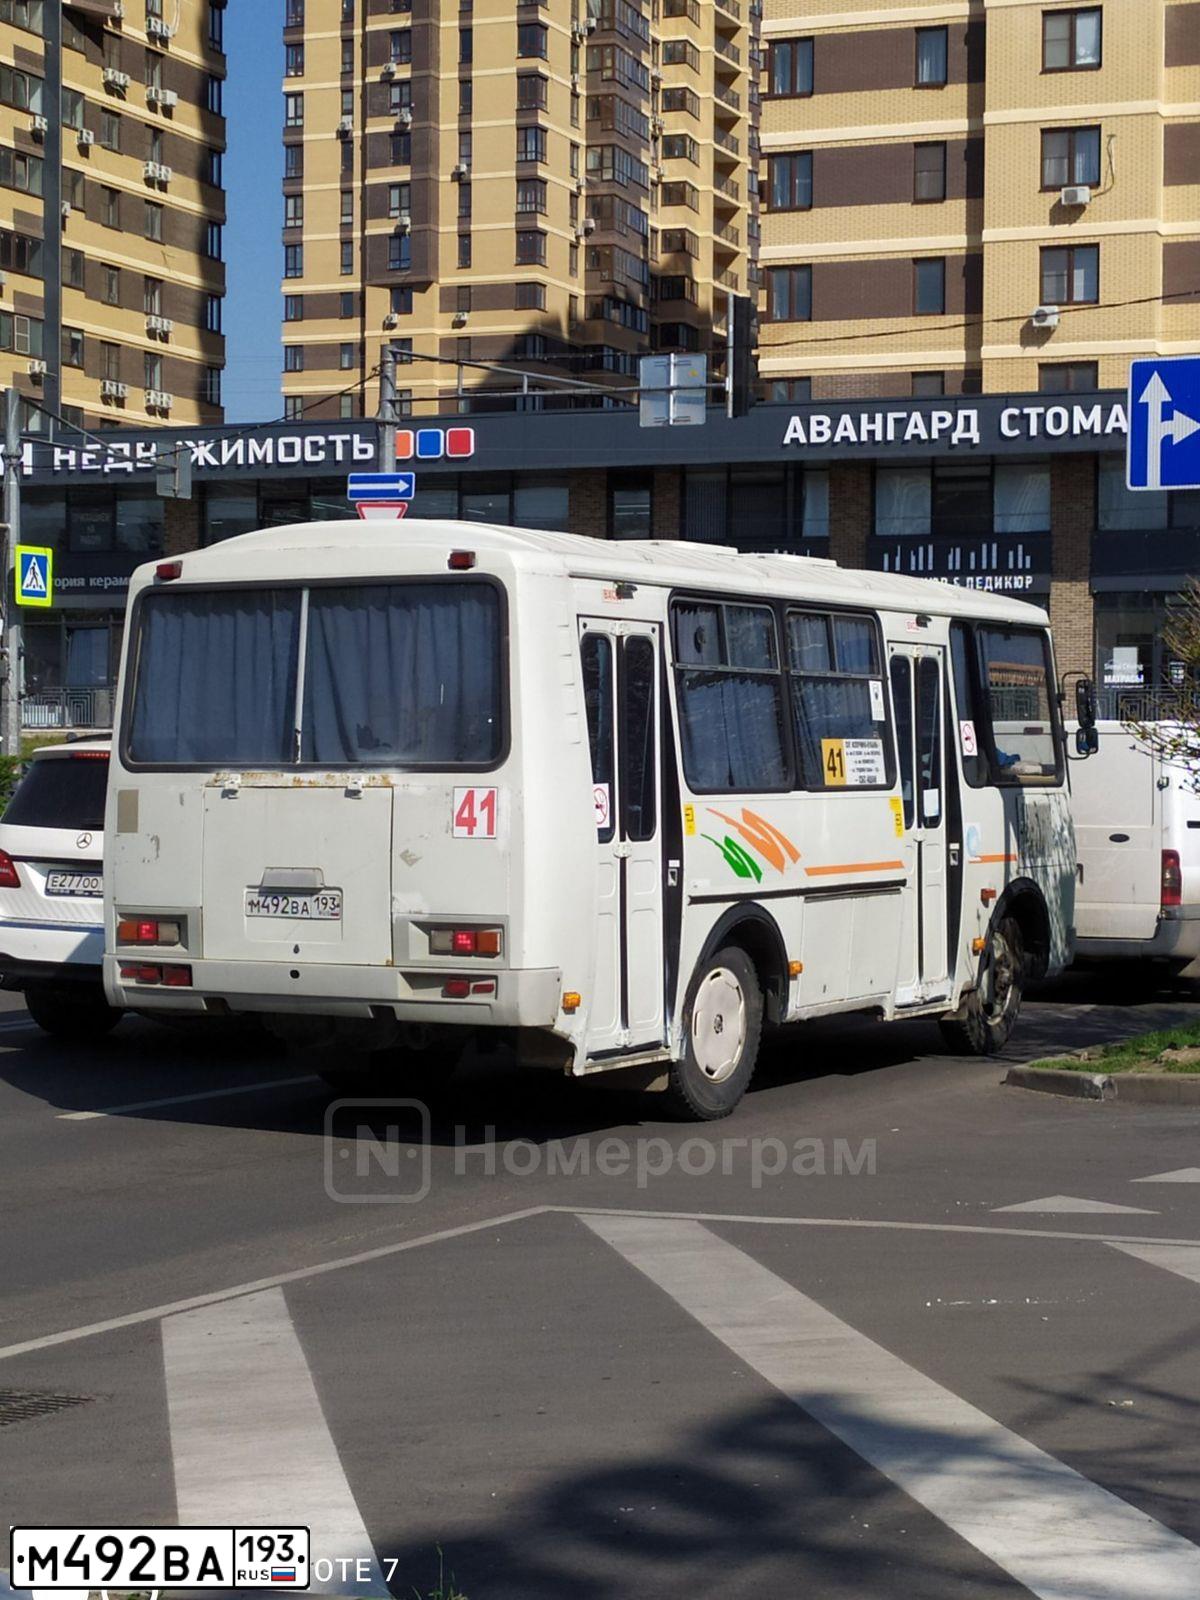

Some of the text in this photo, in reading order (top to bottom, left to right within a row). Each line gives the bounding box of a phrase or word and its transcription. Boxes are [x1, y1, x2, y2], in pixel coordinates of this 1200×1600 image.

[783, 404, 1128, 444] АВАНГАРД СТОМА
[53, 434, 374, 472] НЕДВЖИМОСТЬ
[966, 576, 1033, 591] ПЕДИКЮР
[826, 748, 844, 778] 41
[456, 790, 495, 836] 41
